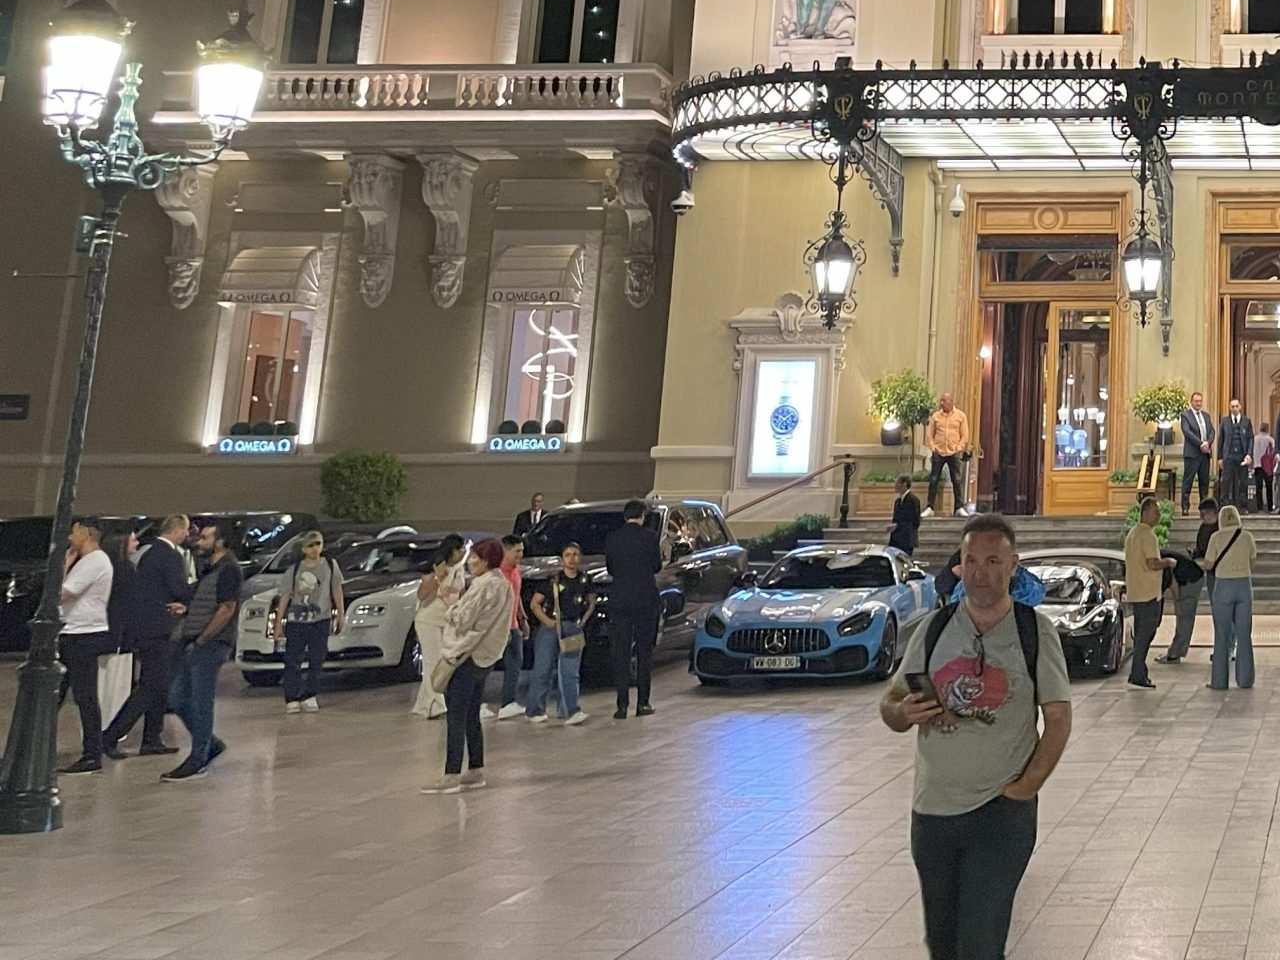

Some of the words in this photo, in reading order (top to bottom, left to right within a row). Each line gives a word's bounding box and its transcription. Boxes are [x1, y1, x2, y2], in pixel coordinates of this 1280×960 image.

[235, 292, 276, 303] OMEGA
[505, 291, 546, 302] OMEGA
[234, 440, 276, 452] OMEGA
[504, 438, 546, 450] OMEGA
